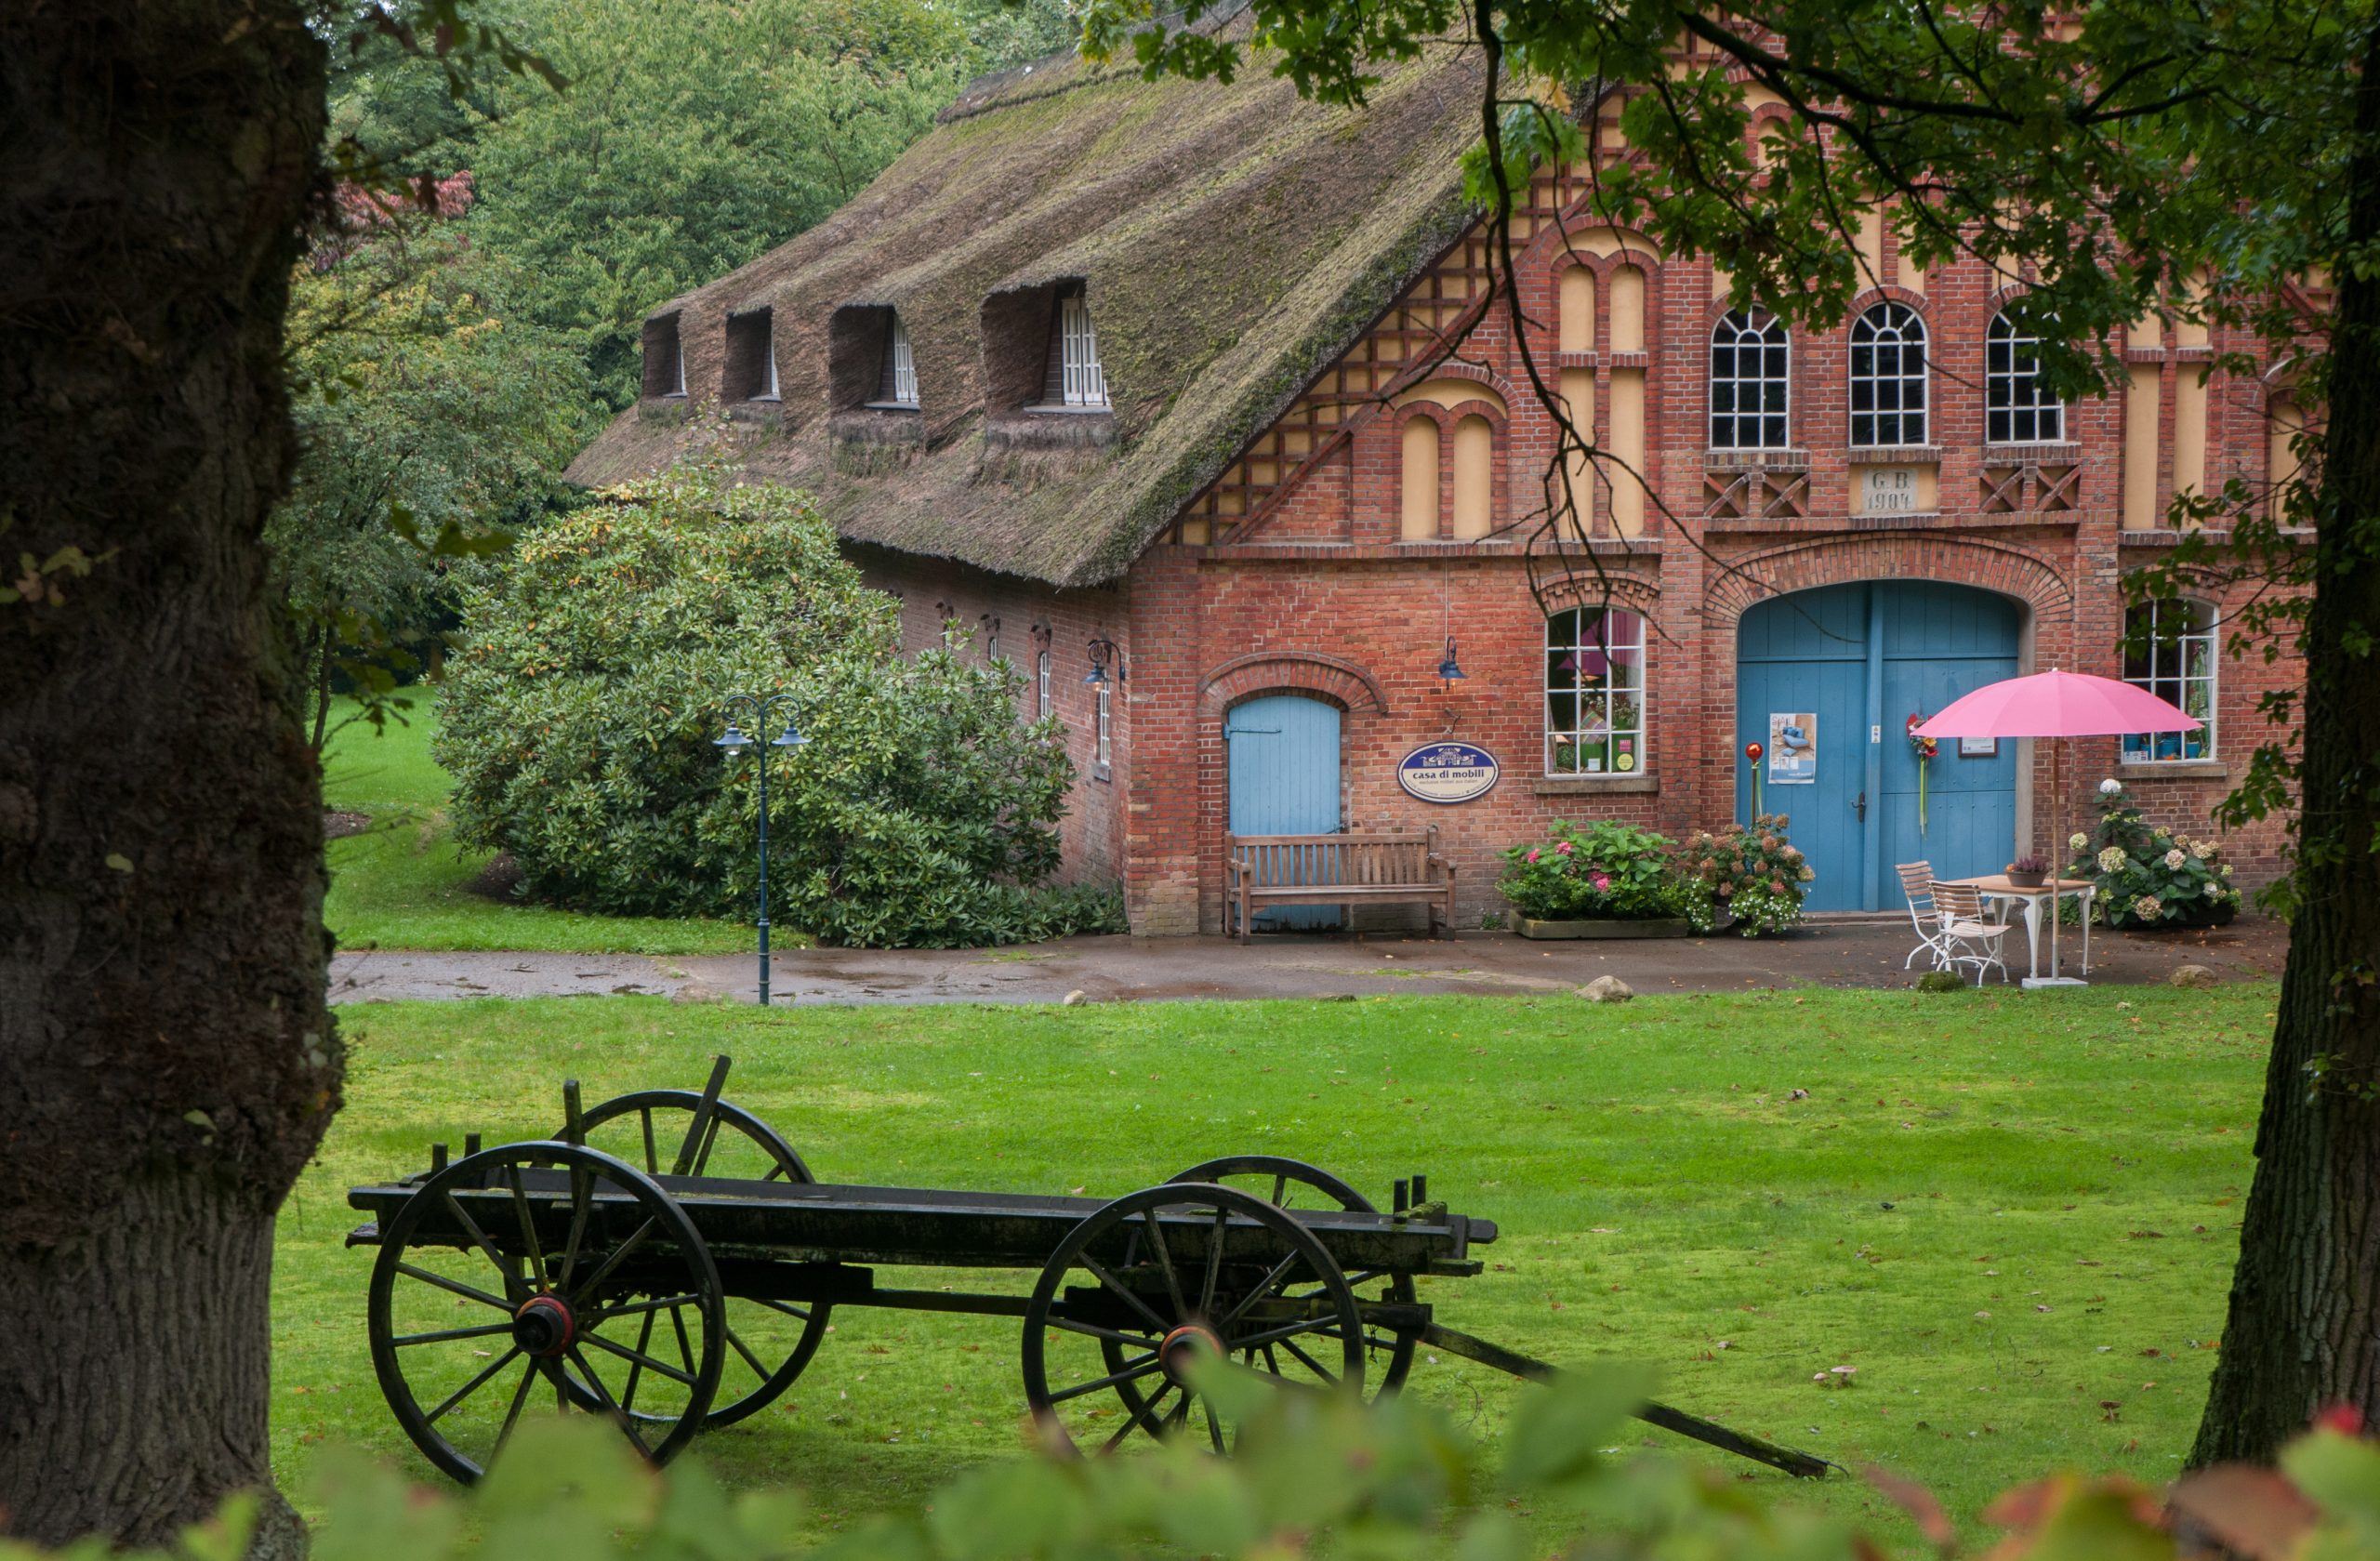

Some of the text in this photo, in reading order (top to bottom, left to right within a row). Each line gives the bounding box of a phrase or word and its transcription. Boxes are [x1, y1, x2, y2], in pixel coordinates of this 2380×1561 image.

[1895, 472, 1911, 489] B.
[1439, 770, 1449, 778] di
[1452, 769, 1485, 778] mobili
